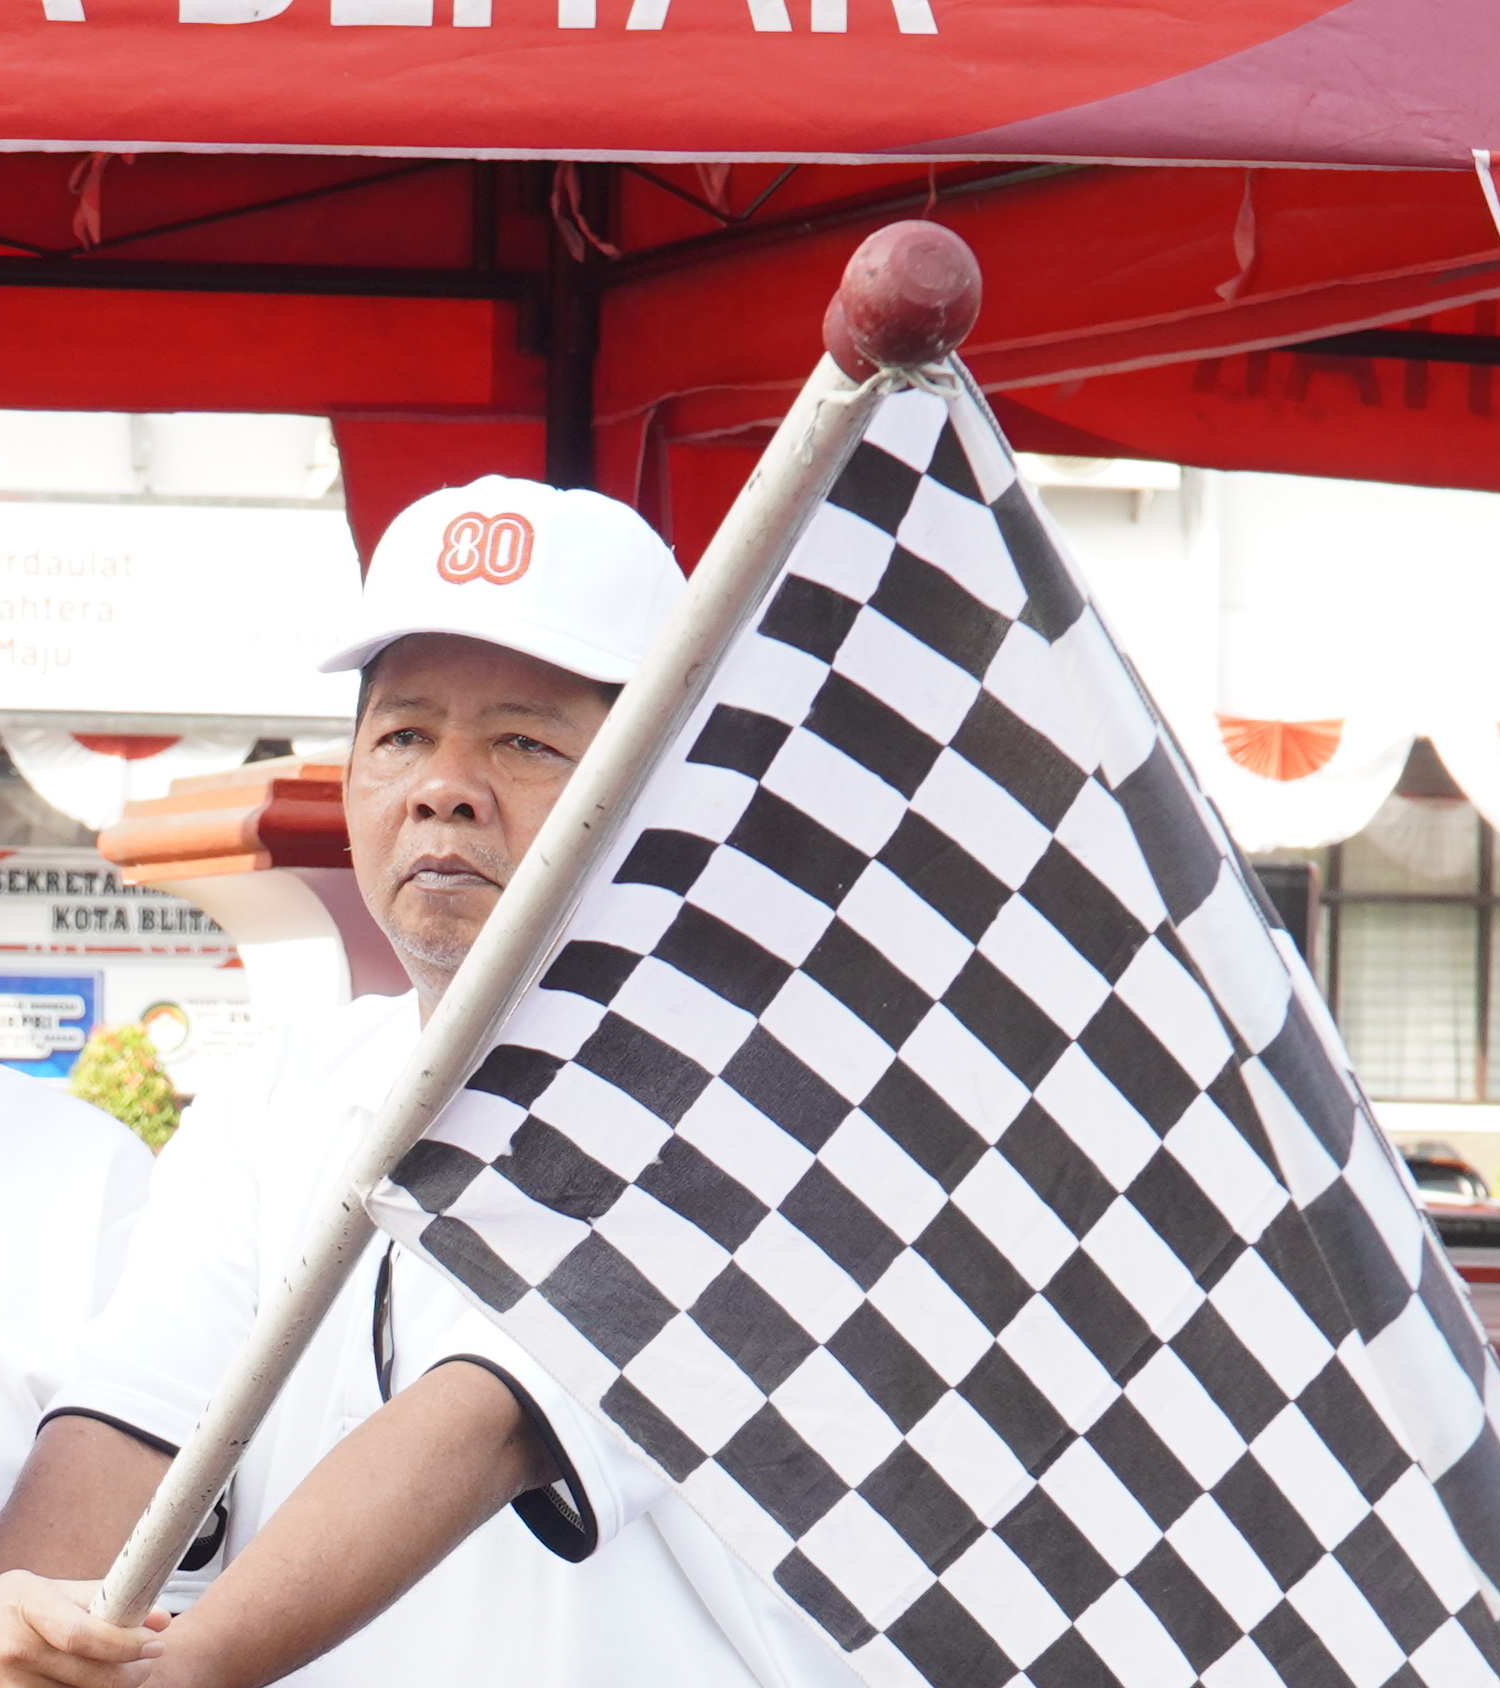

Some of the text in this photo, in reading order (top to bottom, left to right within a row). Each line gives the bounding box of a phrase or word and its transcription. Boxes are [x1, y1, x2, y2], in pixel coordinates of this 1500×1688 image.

[437, 511, 535, 585] 80
[52, 905, 226, 934] KOTA BLITA
